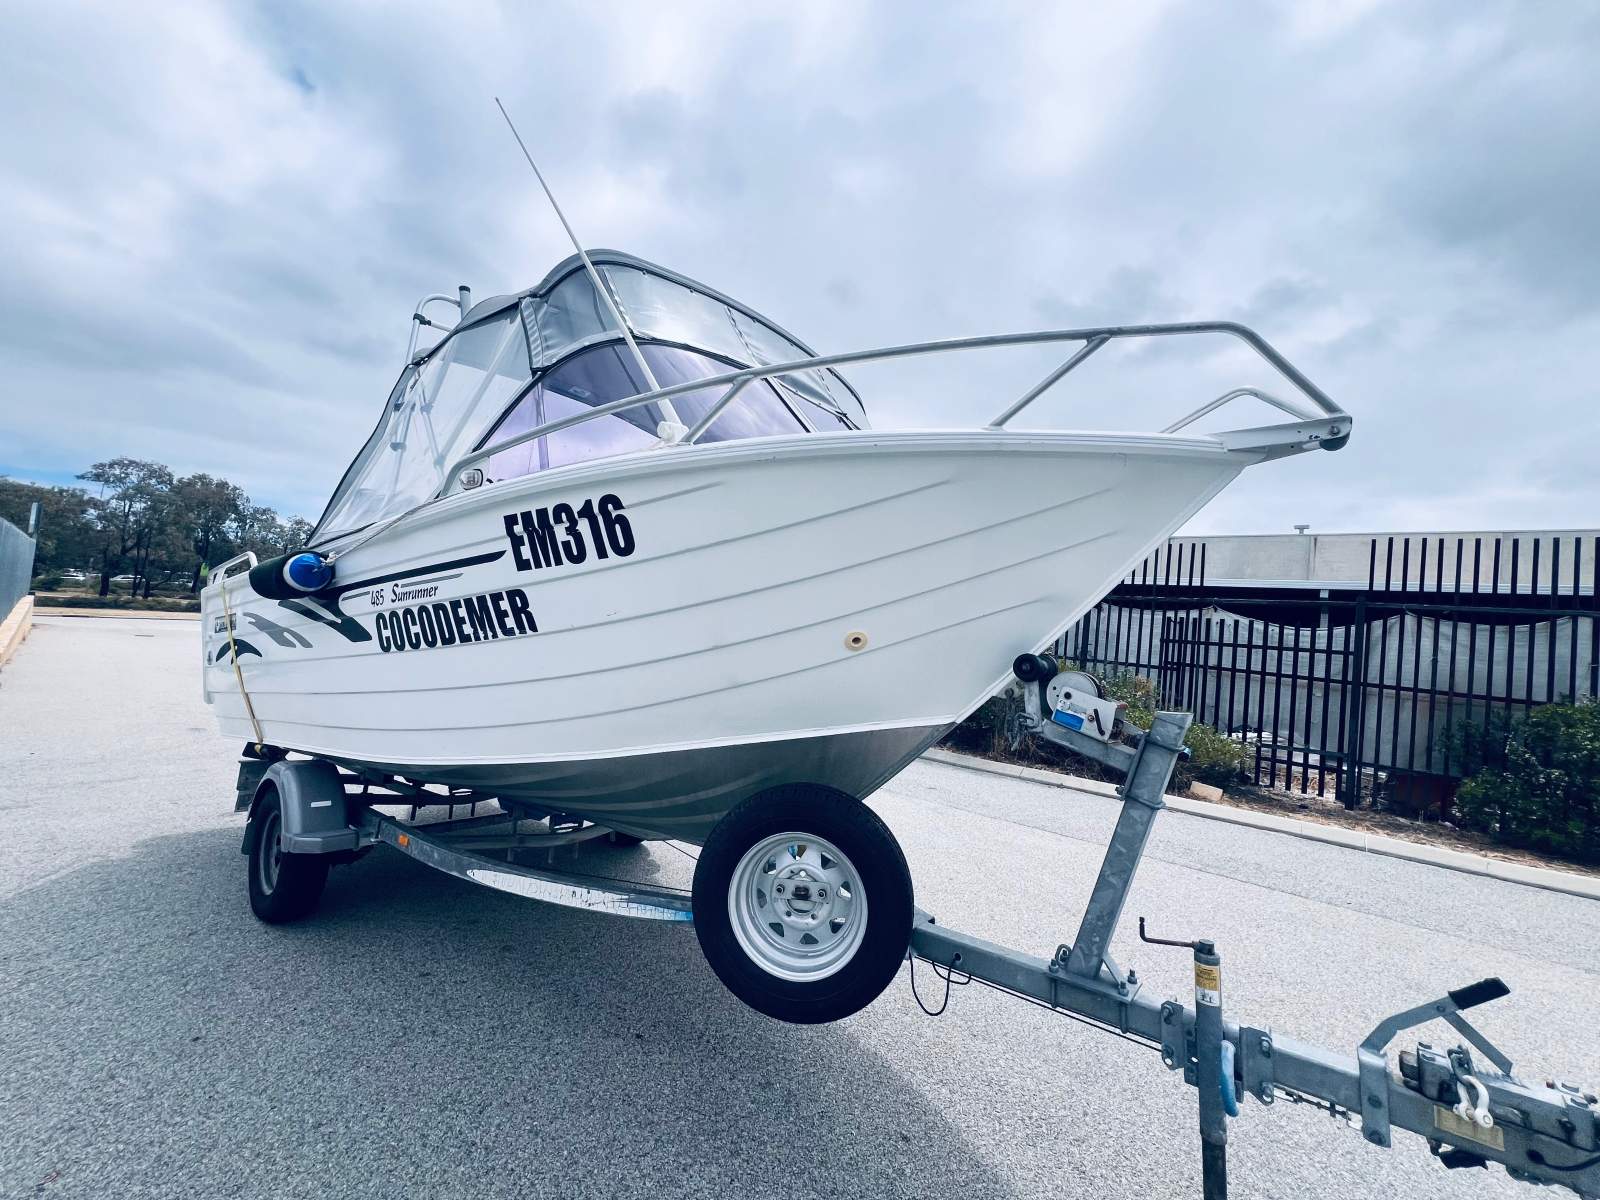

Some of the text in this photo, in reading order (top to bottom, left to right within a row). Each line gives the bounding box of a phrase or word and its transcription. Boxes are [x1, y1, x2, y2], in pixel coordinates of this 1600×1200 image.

[503, 493, 635, 572] EM316
[371, 583, 438, 607] 485 Sunrunner
[375, 588, 538, 653] COCODEMER
